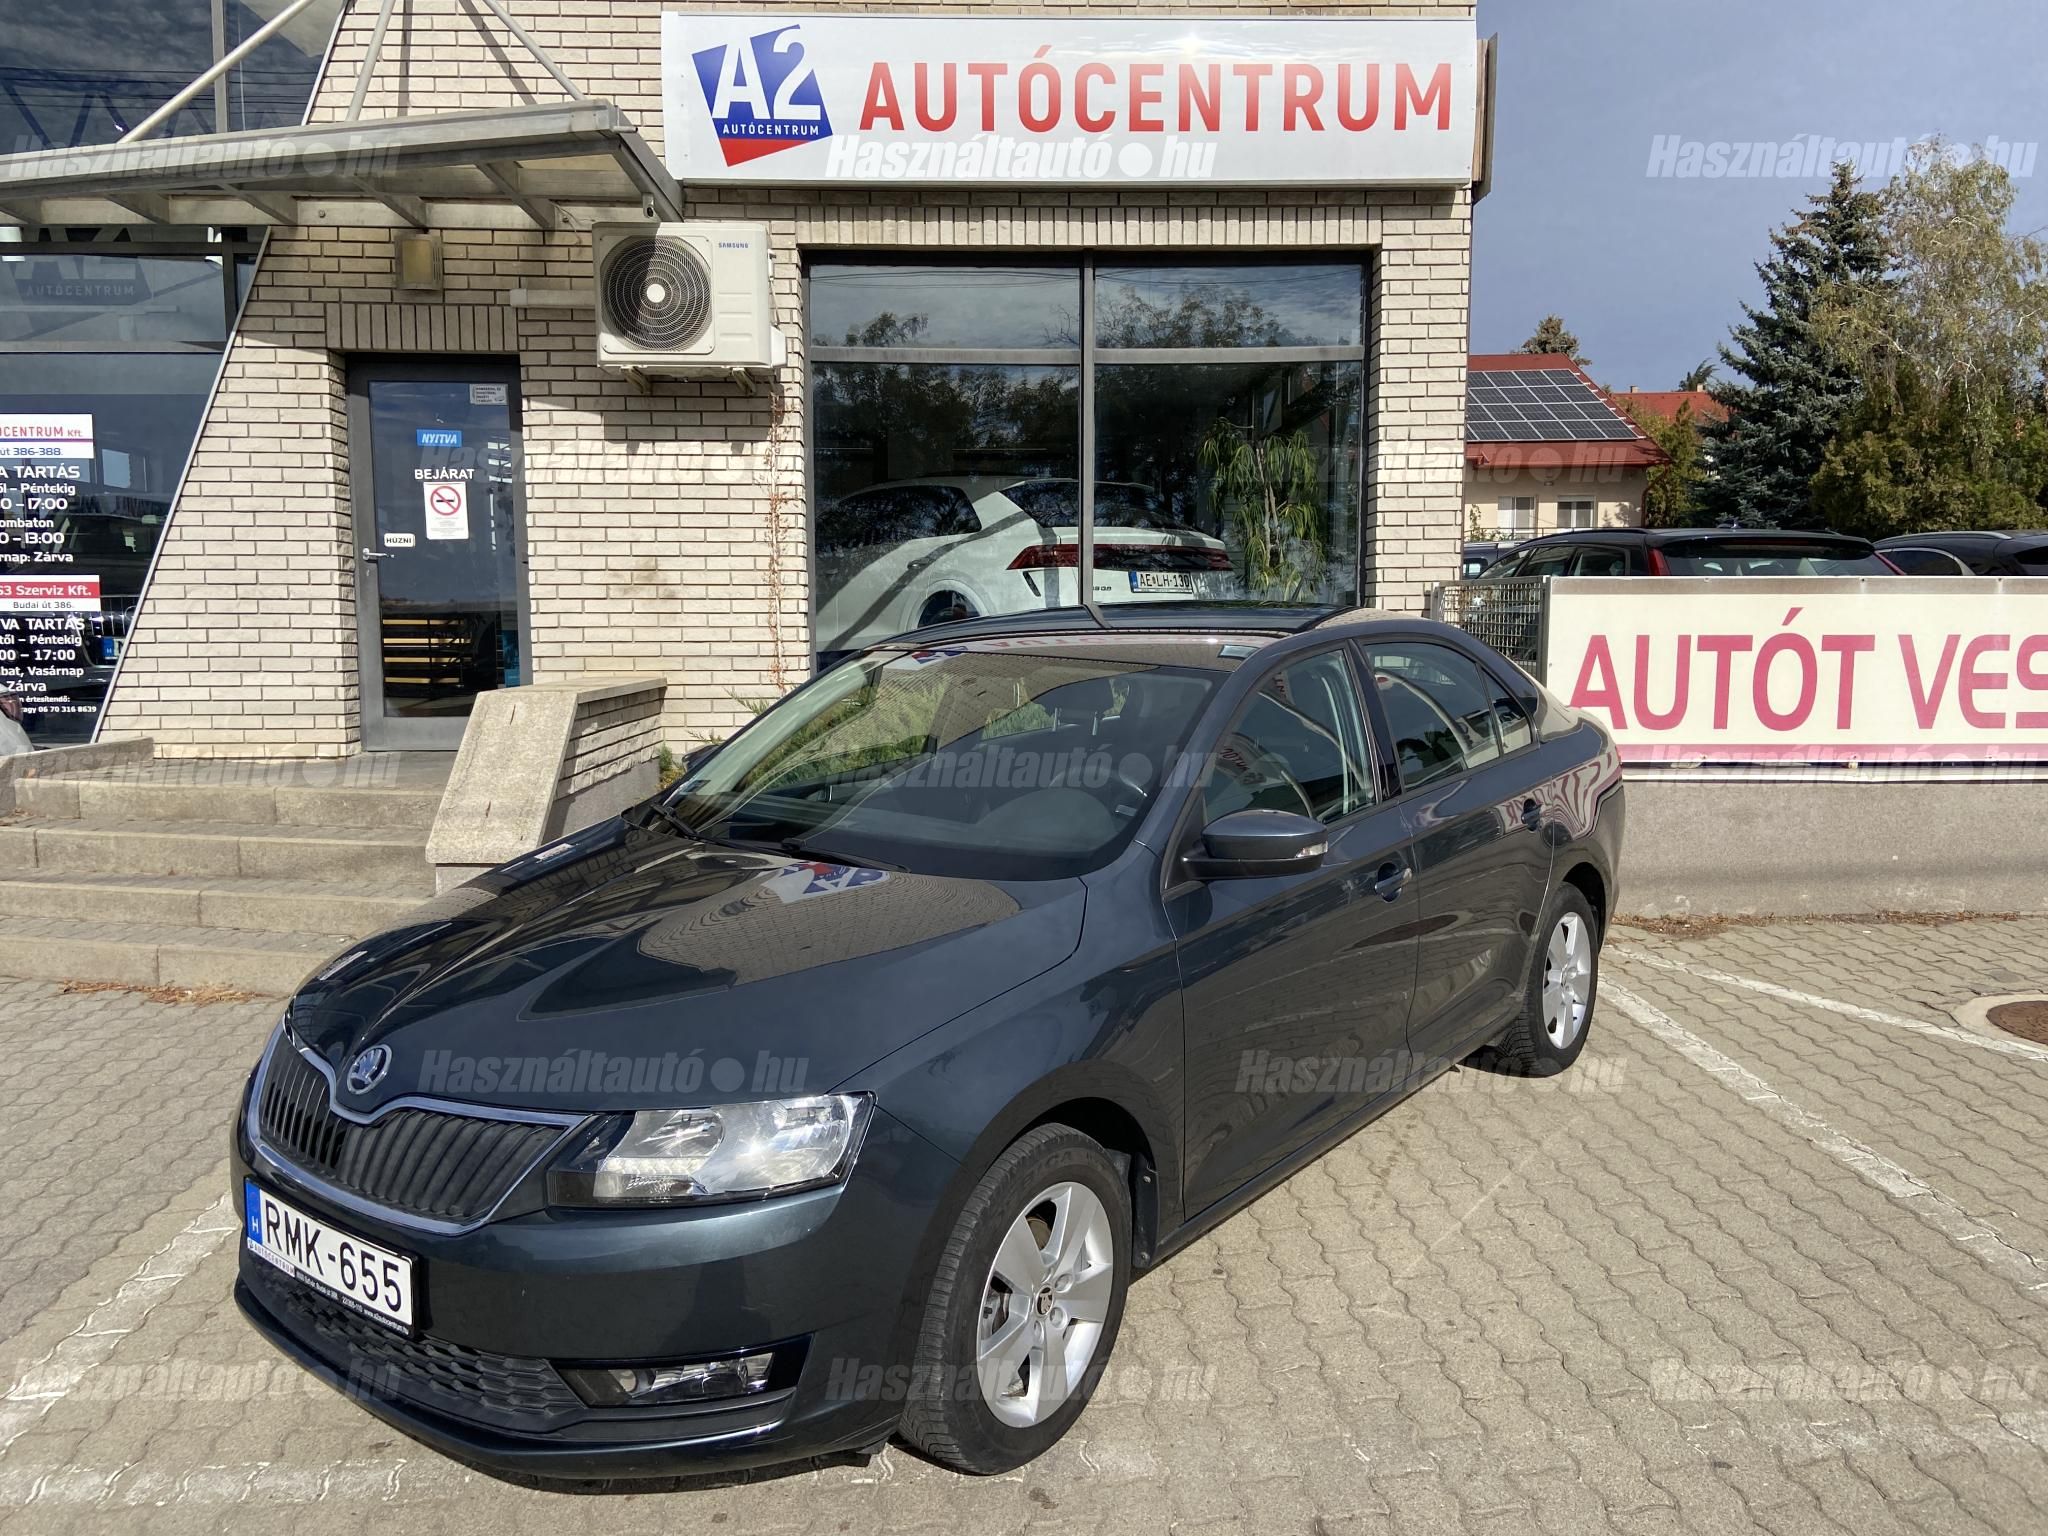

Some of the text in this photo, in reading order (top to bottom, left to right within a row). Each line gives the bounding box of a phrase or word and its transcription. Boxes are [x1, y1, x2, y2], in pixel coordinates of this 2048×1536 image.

[712, 28, 821, 120] A2
[859, 44, 1452, 133] AUTÓCENTRUM
[723, 121, 820, 136] AUTÓCENTRUM
[421, 433, 458, 444] NYITVA
[13, 462, 80, 479] TARTÁS
[414, 466, 475, 480] BEJÁRAT
[20, 482, 76, 496] Péntekig
[28, 498, 68, 510] 17:00
[25, 532, 65, 544] 13:00
[33, 551, 74, 562] Zárva
[16, 585, 64, 596] Szerviz
[68, 585, 92, 596] Kft.
[13, 601, 39, 609] Budai
[42, 601, 51, 609] út
[25, 614, 86, 630] TARTÁS
[30, 634, 82, 647] Péntekig
[34, 649, 76, 661] 17:00
[27, 665, 84, 678] Vasárnap
[1568, 606, 1876, 731] AUTÓT
[6, 680, 47, 692] Zárva
[265, 1199, 402, 1312] RMK-655
